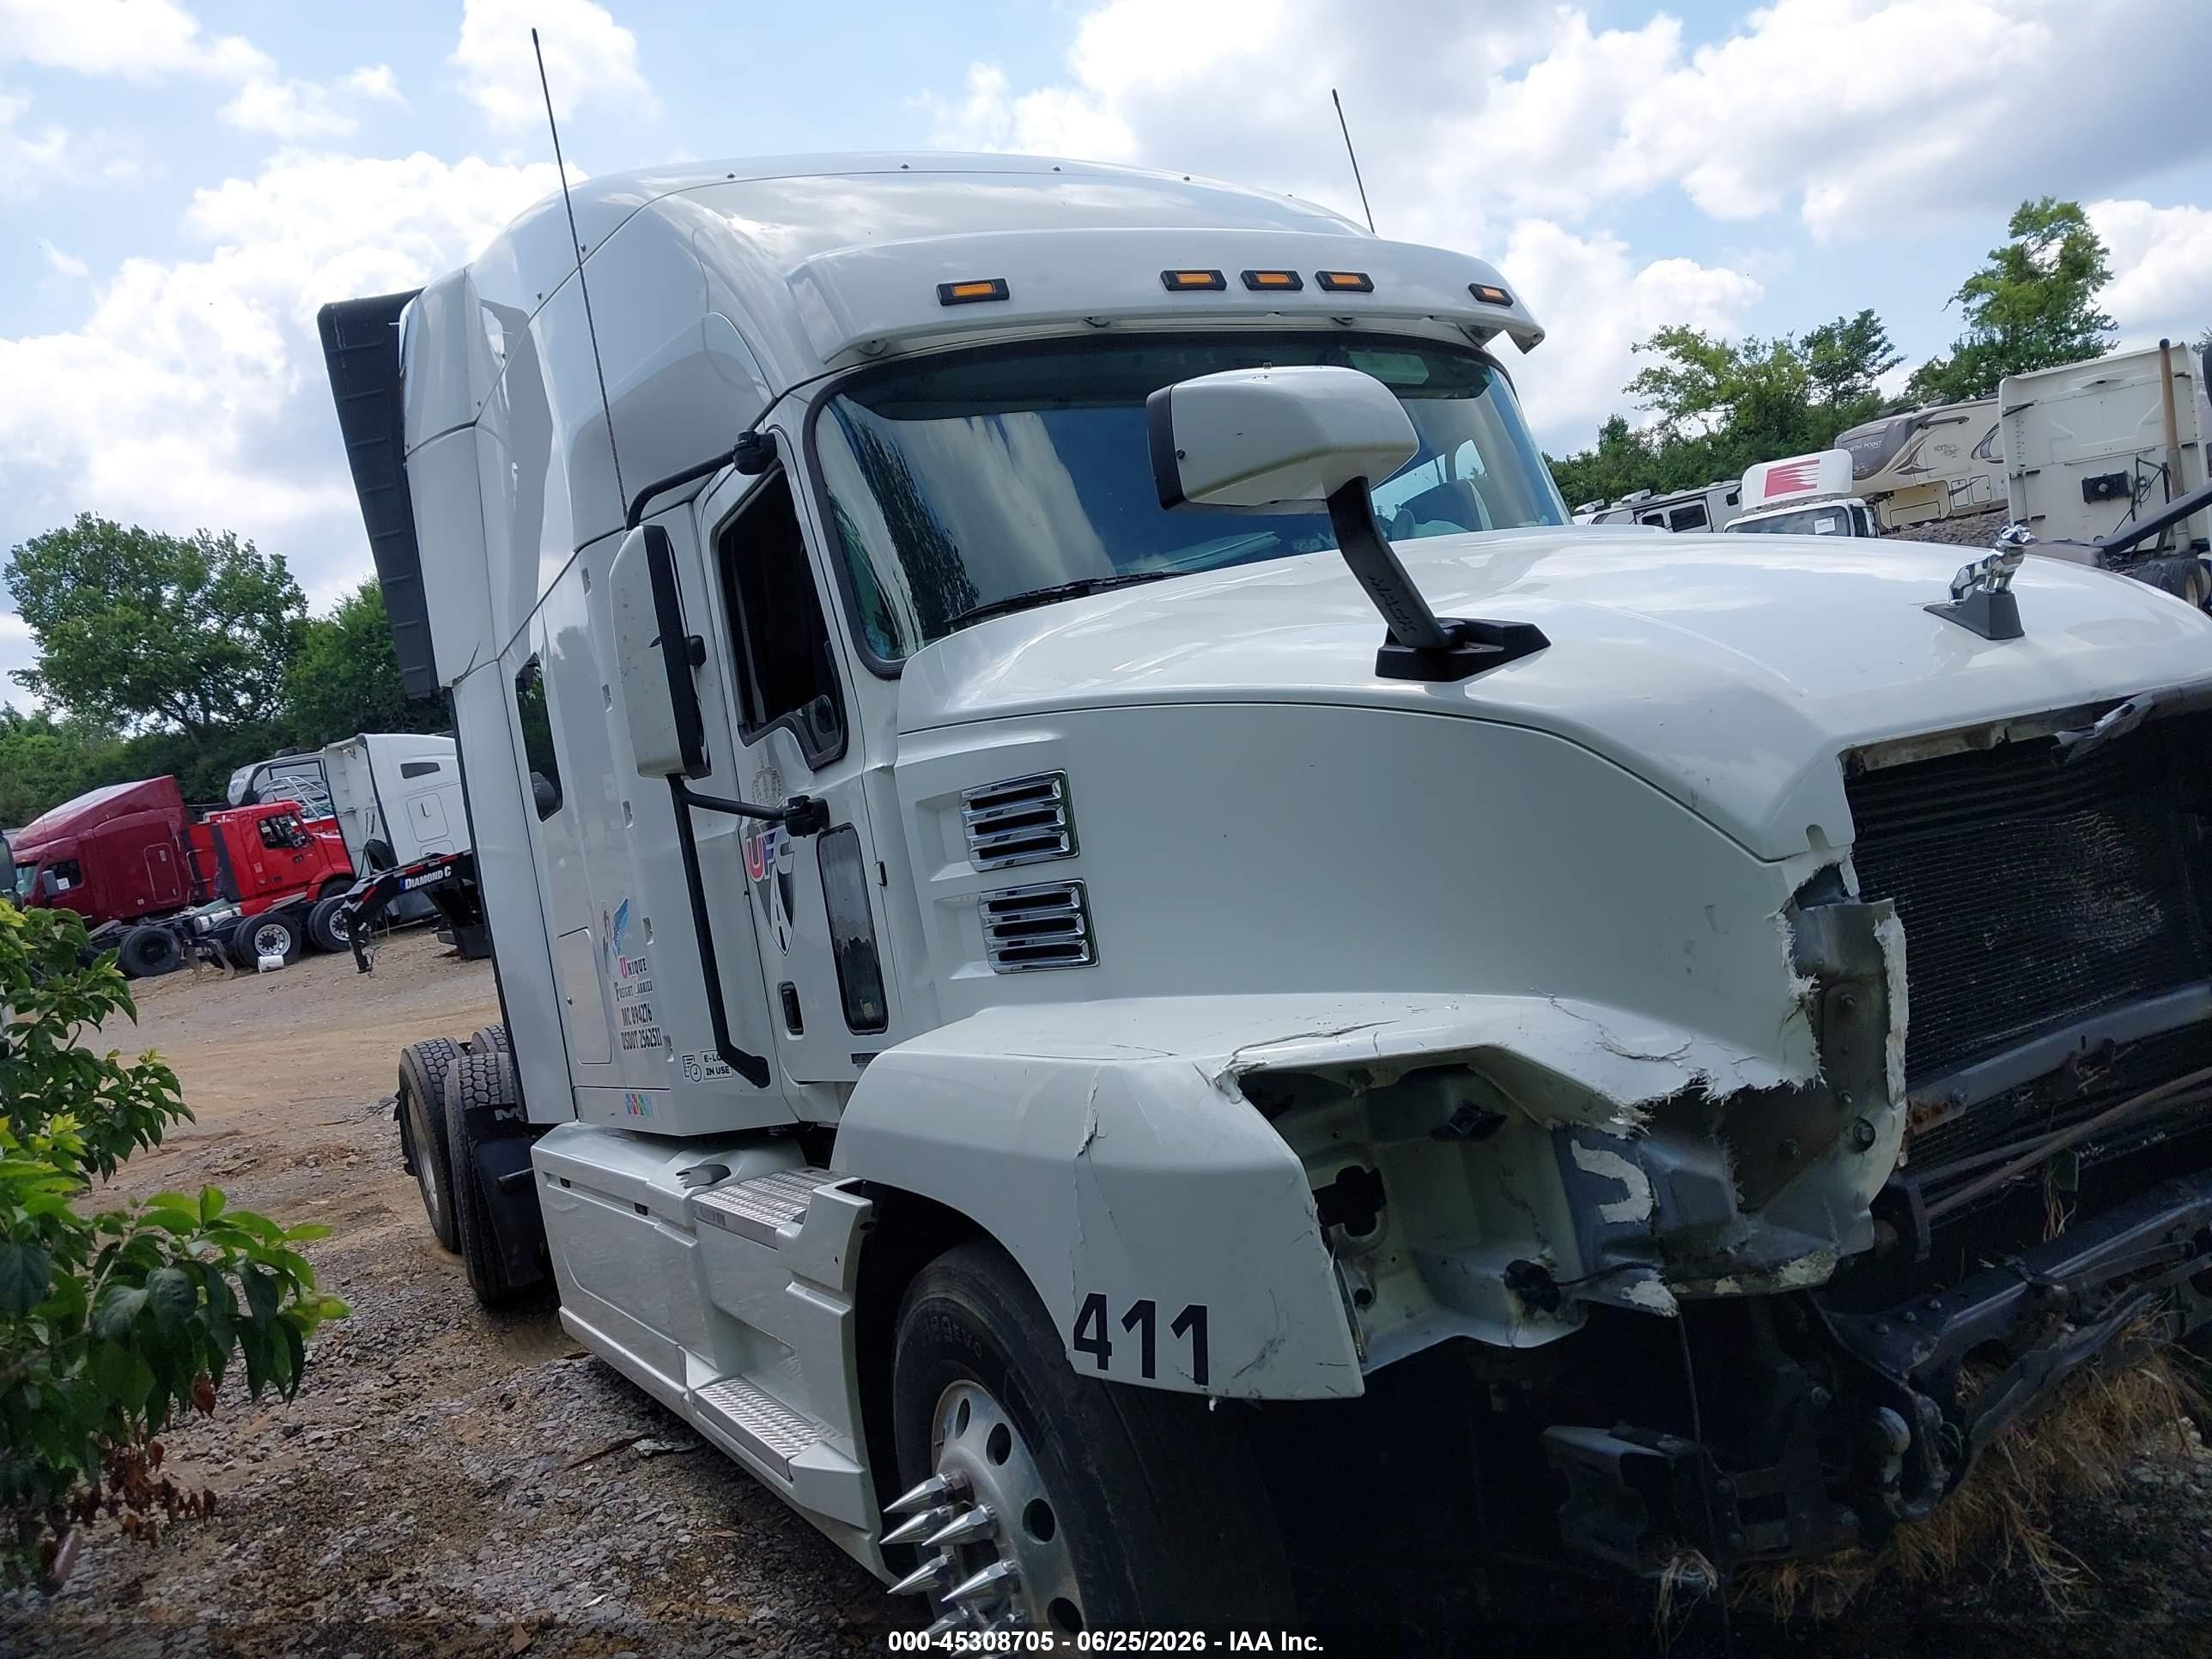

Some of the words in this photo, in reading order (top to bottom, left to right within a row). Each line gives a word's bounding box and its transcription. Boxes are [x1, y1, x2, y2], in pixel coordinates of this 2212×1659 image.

[746, 824, 795, 883] UFC
[404, 869, 443, 890] DIAMOND
[444, 866, 452, 878] C
[621, 1006, 632, 1026] MC
[620, 1030, 639, 1050] USDOT
[705, 1066, 715, 1076] IN
[715, 1065, 730, 1075] USE
[1073, 1292, 1209, 1387] 411
